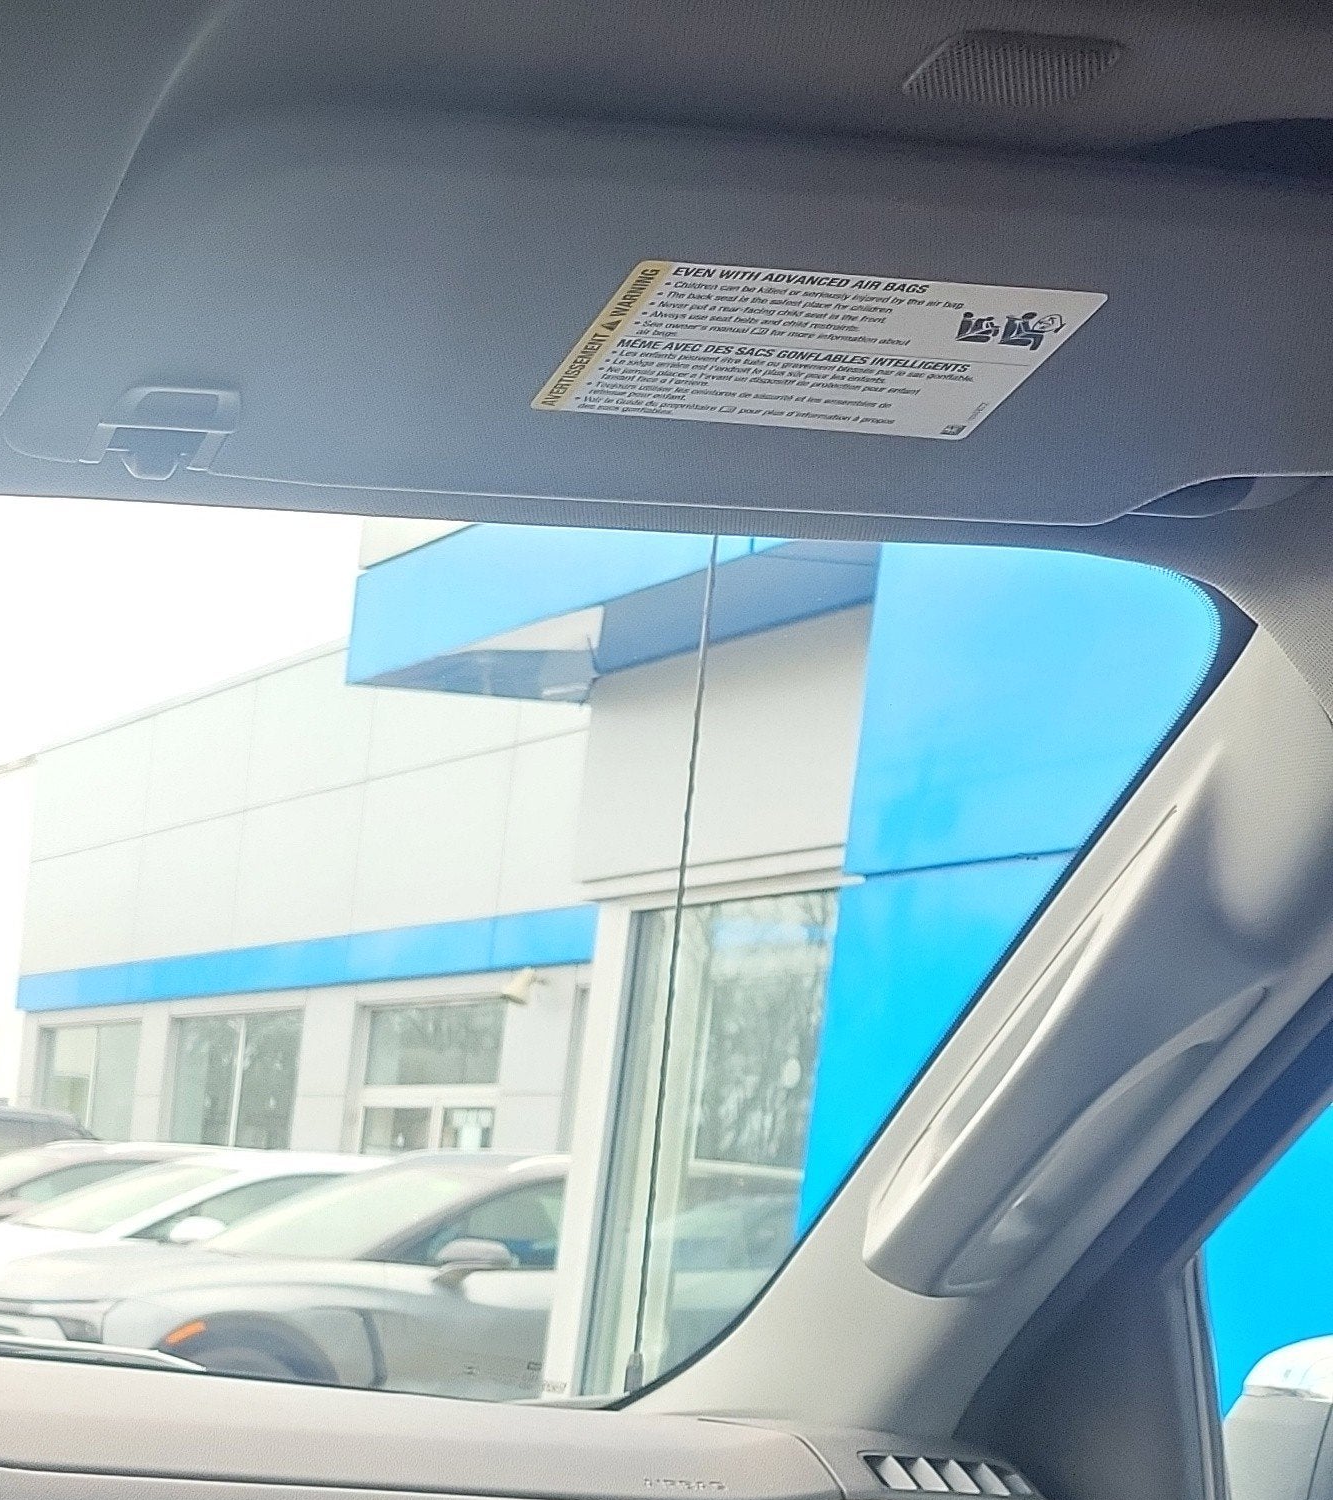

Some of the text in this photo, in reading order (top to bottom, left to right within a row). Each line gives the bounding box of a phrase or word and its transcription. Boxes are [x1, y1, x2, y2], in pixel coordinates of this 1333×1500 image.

[673, 267, 930, 294] EVEN WITH ADVANCED AIR BAGS
[674, 281, 718, 291] Children
[541, 268, 660, 406] AVERTISSEMENT WARNING
[662, 341, 702, 352] AVEC
[703, 344, 733, 354] DES
[735, 346, 775, 357] SACS
[777, 350, 870, 364] GONFLABLES
[870, 357, 970, 372] INTELLIGENTS
